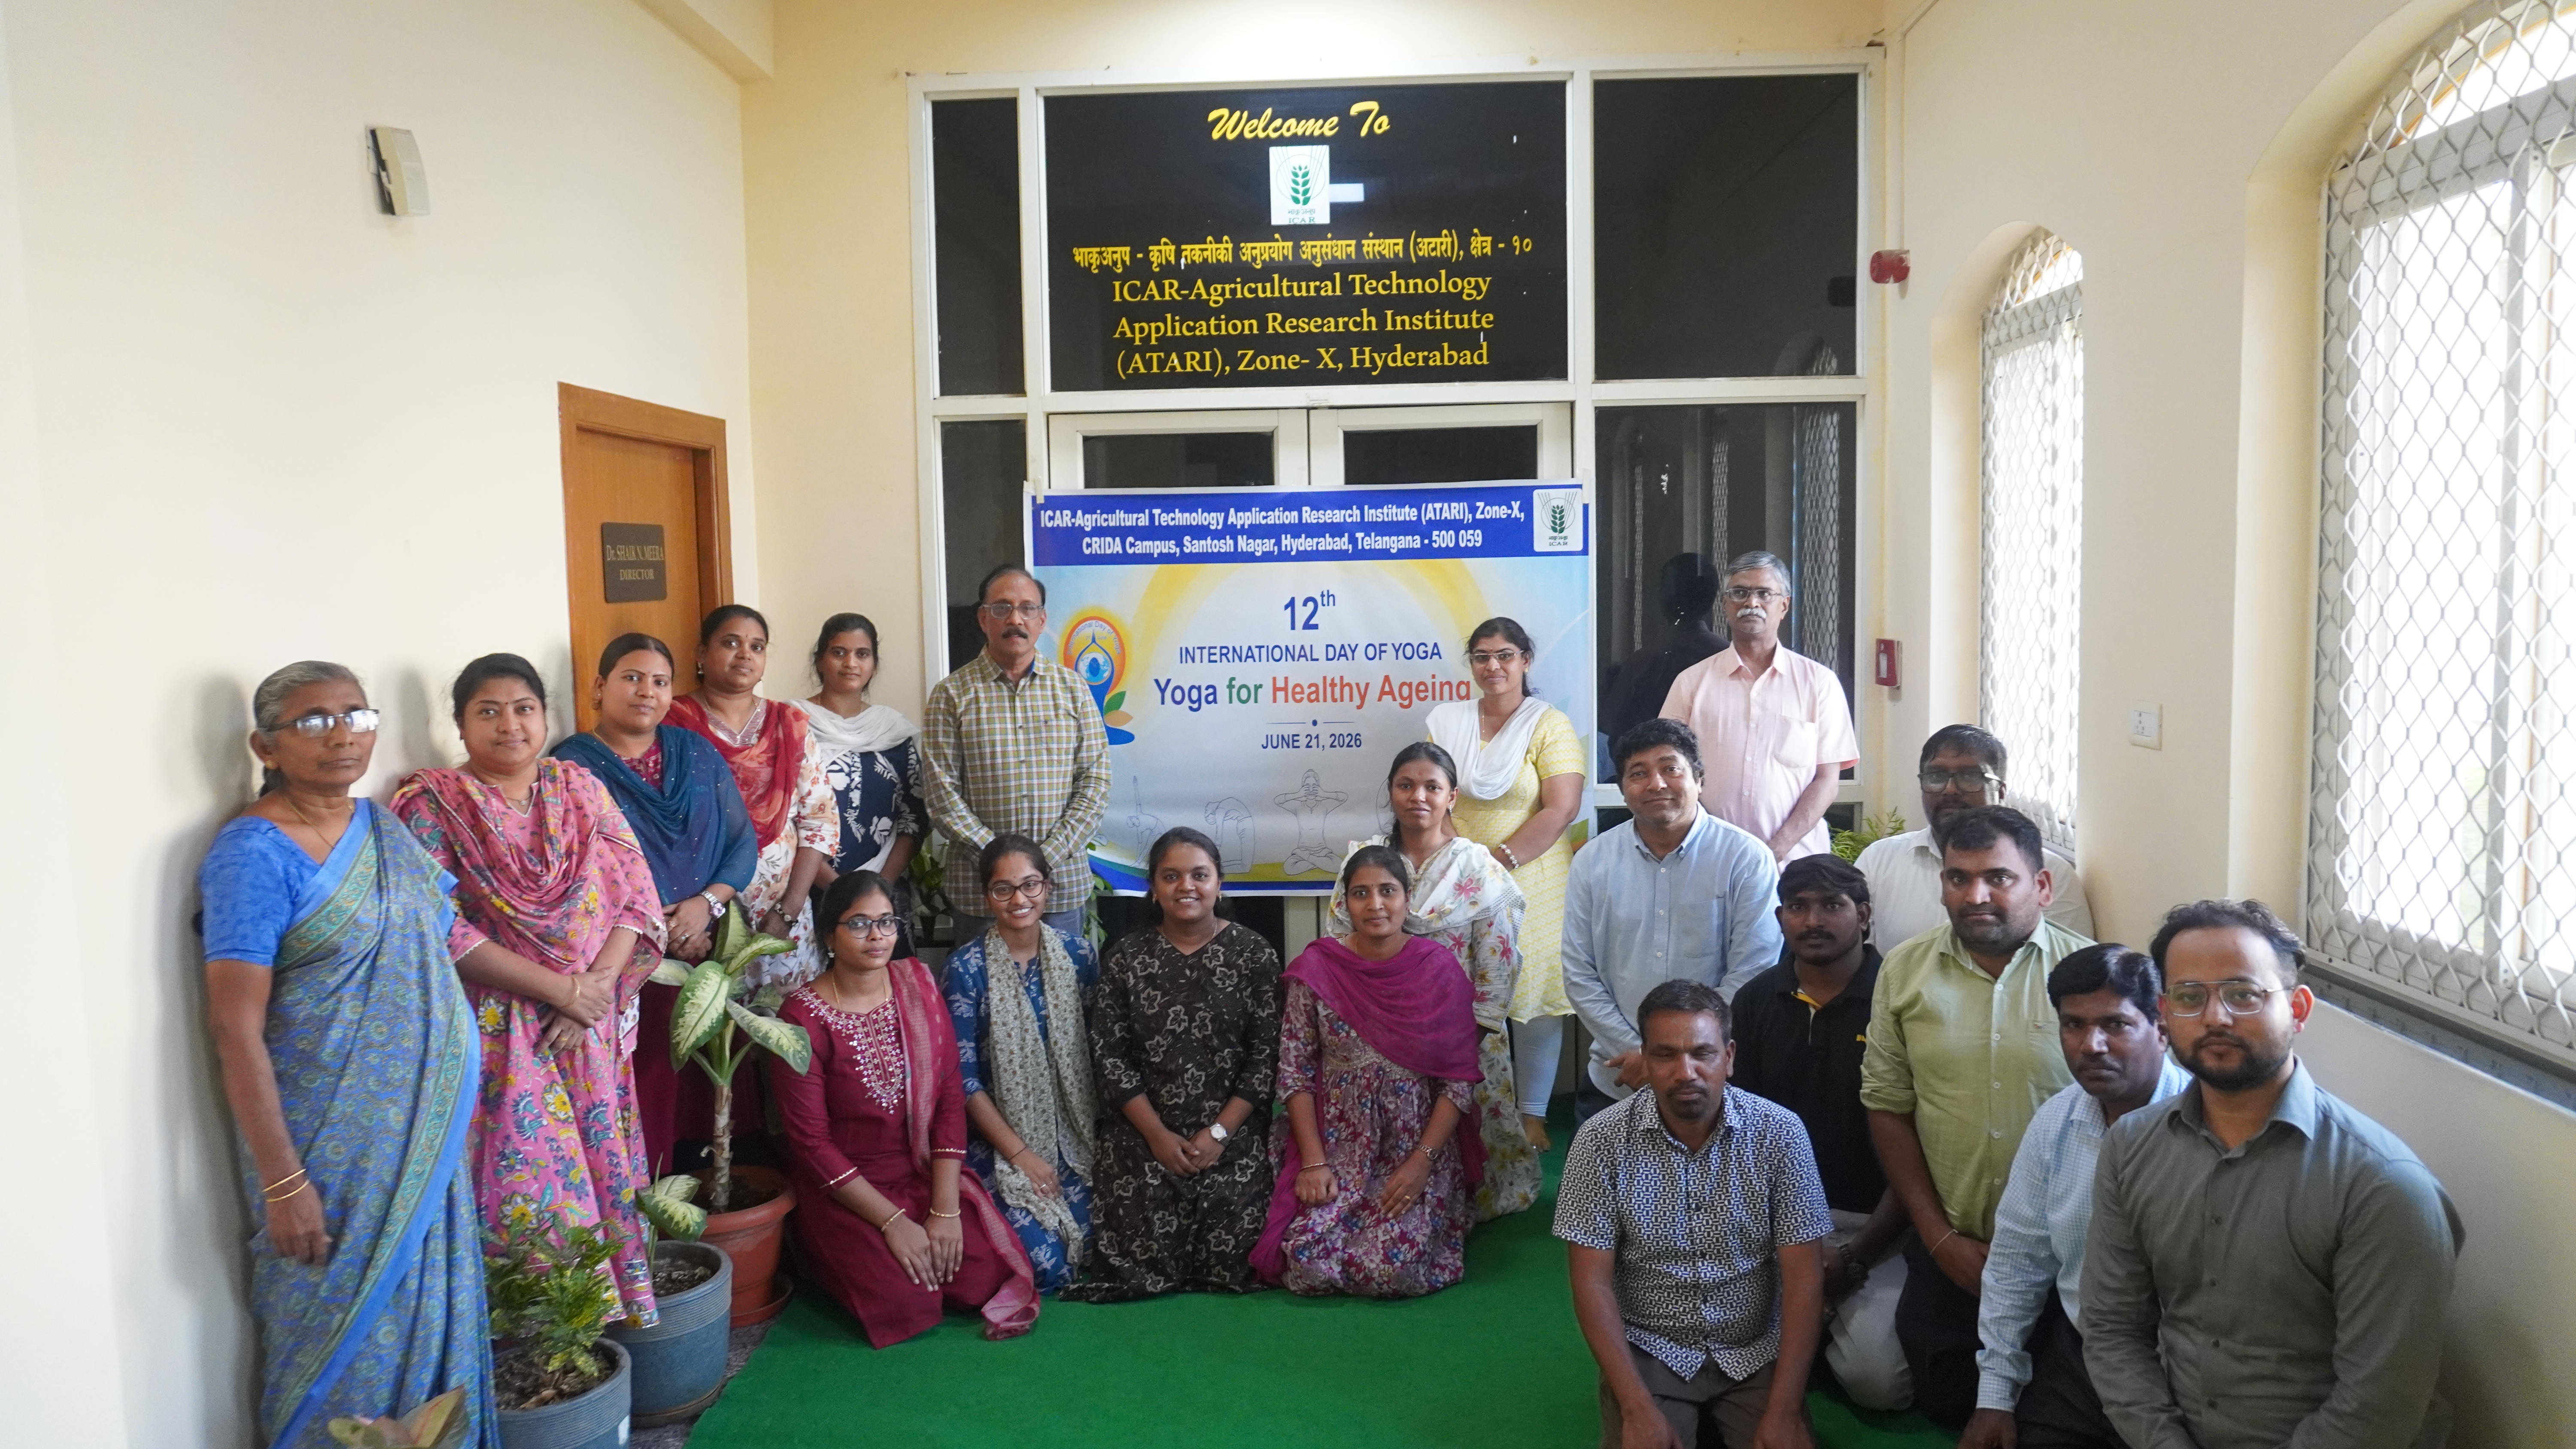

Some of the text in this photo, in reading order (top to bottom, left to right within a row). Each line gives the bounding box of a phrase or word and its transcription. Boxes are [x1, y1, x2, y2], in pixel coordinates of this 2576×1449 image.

[1207, 100, 1391, 140] Welcome To
[1073, 246, 1130, 273] भाकृअनुप
[1148, 237, 1176, 272] कृषि
[1180, 235, 1233, 264] तकनीकी
[1239, 233, 1293, 269] अनुप्रयोग
[1299, 232, 1356, 267] अनुसंधान
[1361, 231, 1404, 260] संस्थान
[1410, 229, 1464, 263] (अटारी),
[1470, 227, 1492, 258] क्षेत्र
[1512, 235, 1532, 256] १०
[1112, 269, 1492, 307] ICAR-Agricultural Technology
[1112, 308, 1494, 345] Application Research Institute
[1117, 341, 1490, 380] (ATARI), Zone- X, Hyderabad
[1040, 500, 1525, 531] ICAR-Agricultural Technology Application Research Institute (ATARI), Zone-X,
[1082, 536, 1123, 555] CRIDA
[1125, 536, 1180, 558] Campus,
[1182, 535, 1234, 554] Santosh
[1237, 534, 1278, 556] Nagar,
[1281, 532, 1352, 555] Hyderabad,
[1355, 531, 1421, 554] Telangana
[1431, 530, 1455, 548] 500
[1458, 529, 1482, 547] 059
[619, 568, 655, 581] DIRECTOR
[1284, 589, 1336, 631] 12th
[1179, 642, 1443, 664] INTERNATIONAL DAY OF YOGA
[1153, 674, 1471, 712] Yoga for Healthy Ageing
[1261, 733, 1362, 751] JUNE 21, 2026
